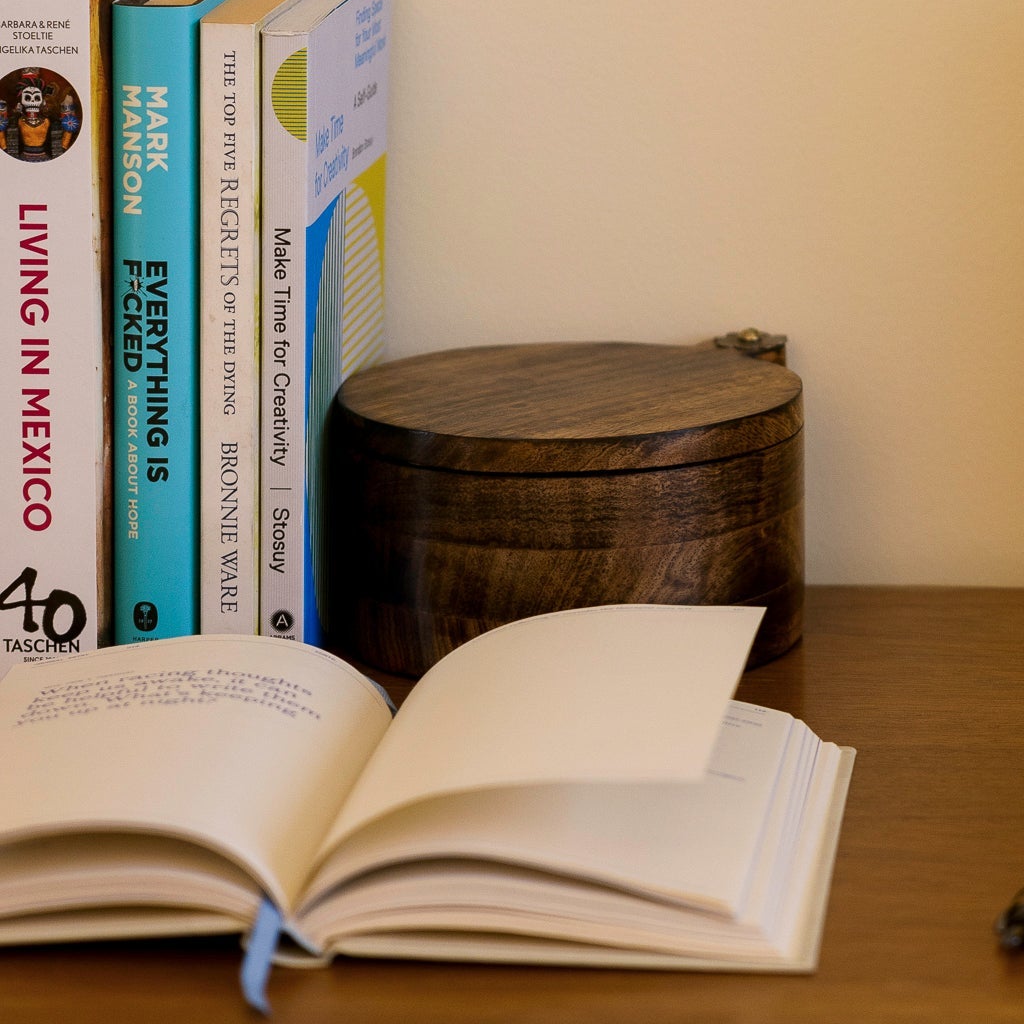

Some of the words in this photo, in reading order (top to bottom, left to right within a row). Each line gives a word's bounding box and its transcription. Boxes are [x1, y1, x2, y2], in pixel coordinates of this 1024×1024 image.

[12, 31, 54, 40] STOELTIE
[38, 20, 45, 29] &
[46, 19, 71, 29] RENÉ
[0, 45, 35, 54] GELIKA
[36, 45, 79, 55] TASCHEN
[223, 50, 236, 87] THE
[146, 86, 169, 173] MARK
[223, 93, 236, 126] TOP
[122, 85, 143, 215] MANSON
[223, 132, 236, 171] FIVE
[315, 125, 330, 158] Make
[330, 114, 344, 142] Time
[314, 171, 323, 198] for
[323, 144, 350, 188] Creativity
[220, 177, 239, 286] REGRETS
[19, 204, 50, 326] LIVING
[274, 228, 291, 281] Make
[223, 292, 236, 314] OF
[274, 286, 291, 334] Time
[21, 338, 50, 375] IN
[146, 261, 169, 447] EVERYTHING
[223, 319, 236, 356] THE
[273, 339, 290, 367] for
[127, 379, 138, 390] A
[223, 361, 236, 416] DYING
[127, 395, 139, 438] BOOK
[270, 372, 291, 466] Creativity
[22, 388, 53, 532] MEXICO
[127, 443, 139, 494] ABOUT
[147, 457, 169, 483] IS
[220, 442, 239, 543] BRONNIE
[127, 499, 139, 540] HOPE
[269, 508, 290, 574] Stosuy
[220, 549, 239, 614] WARE
[0, 567, 87, 644] 40
[3, 638, 80, 653] TASCHEN
[40, 680, 108, 696] When
[118, 670, 196, 683] racing
[206, 668, 313, 696] thoughts
